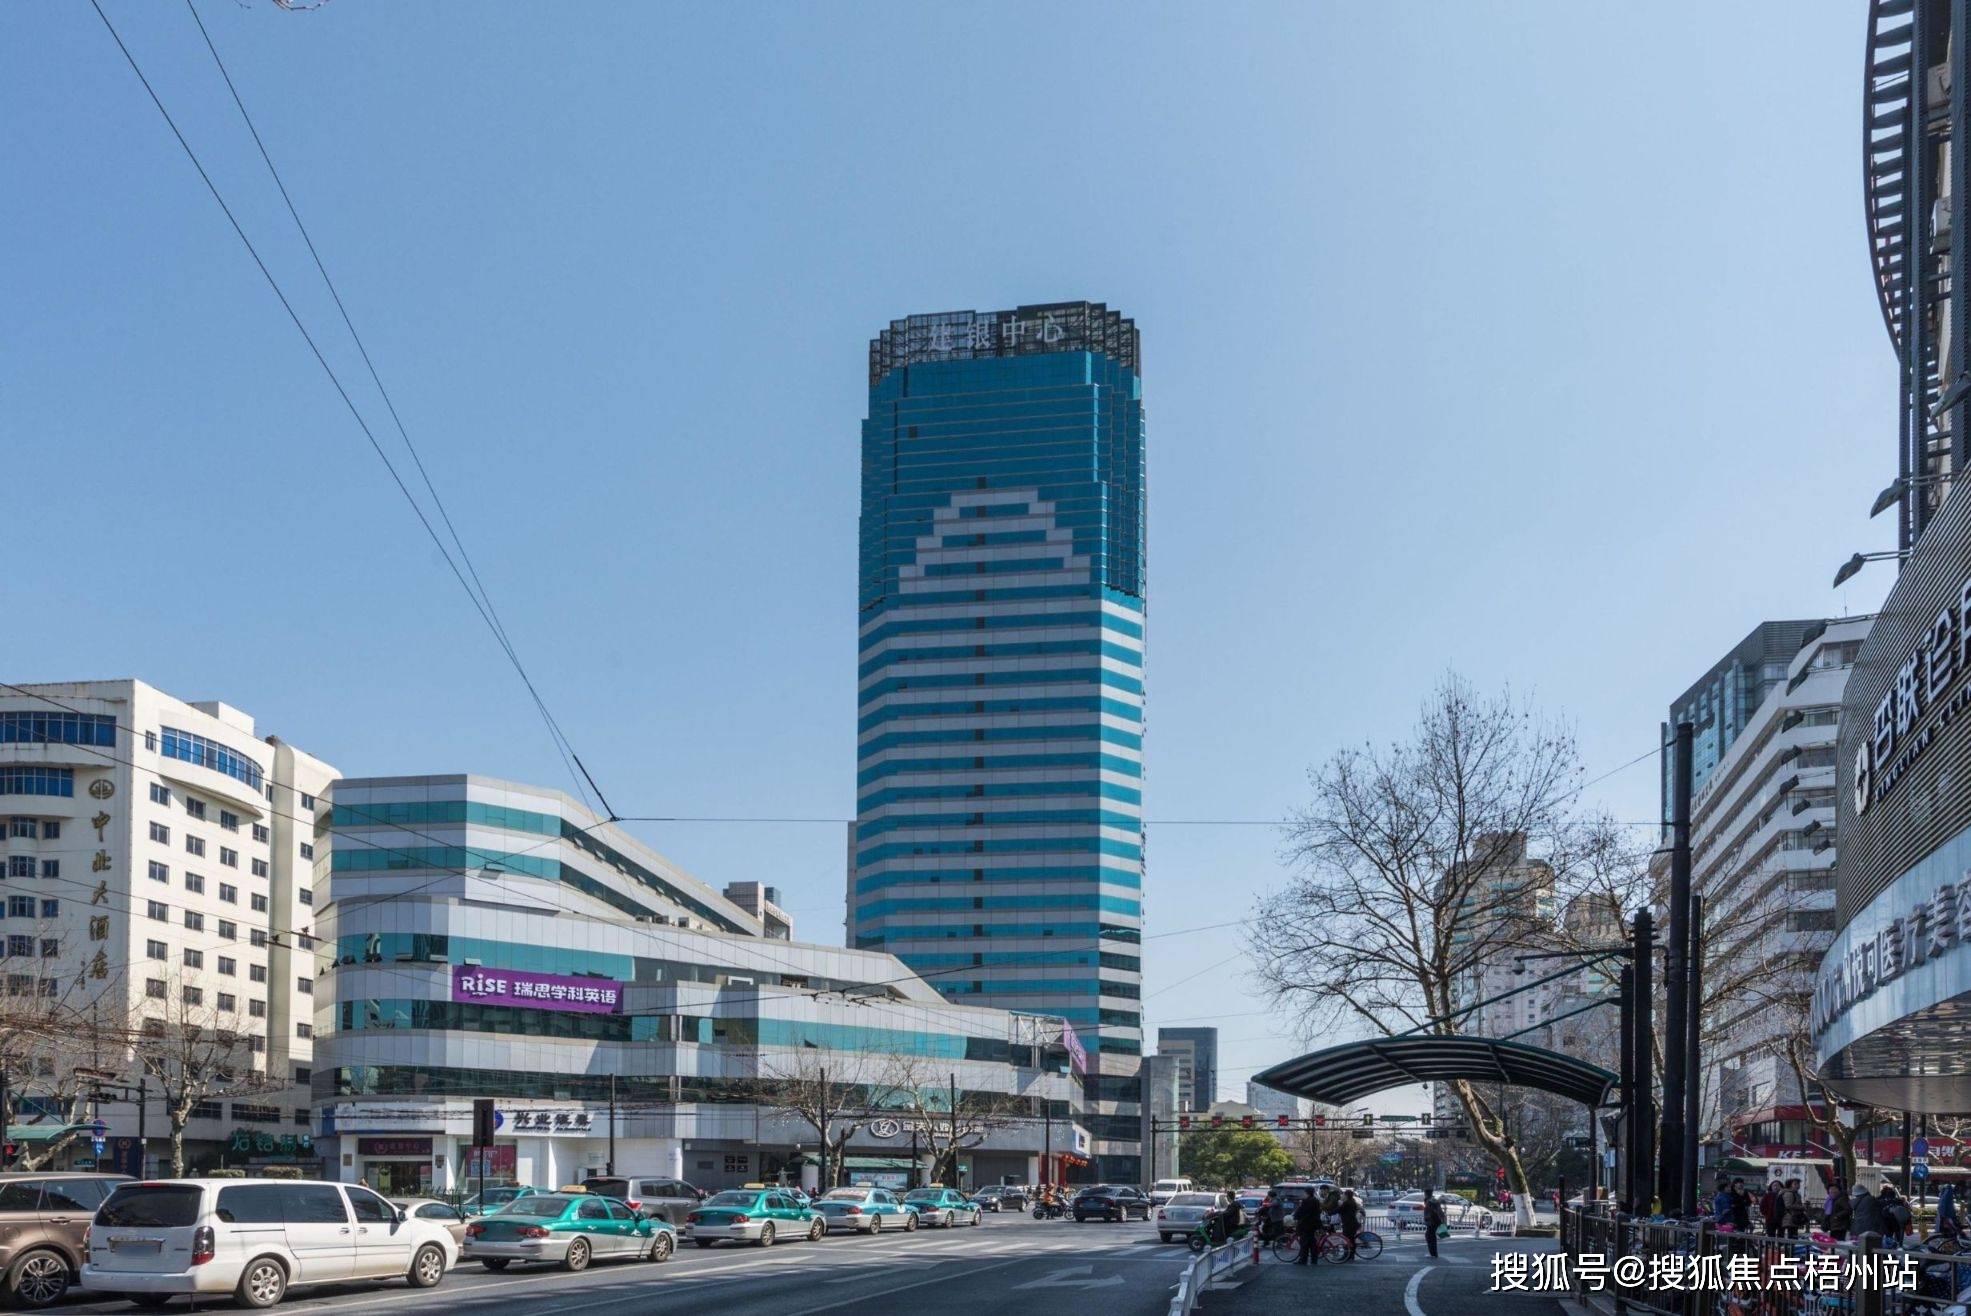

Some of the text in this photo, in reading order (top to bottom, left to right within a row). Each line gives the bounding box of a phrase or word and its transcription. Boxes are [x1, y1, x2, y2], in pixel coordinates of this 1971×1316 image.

[928, 314, 1065, 351] 建银中心
[89, 810, 111, 979] 中北大酒店
[514, 981, 617, 1004] 瑞思学科英语
